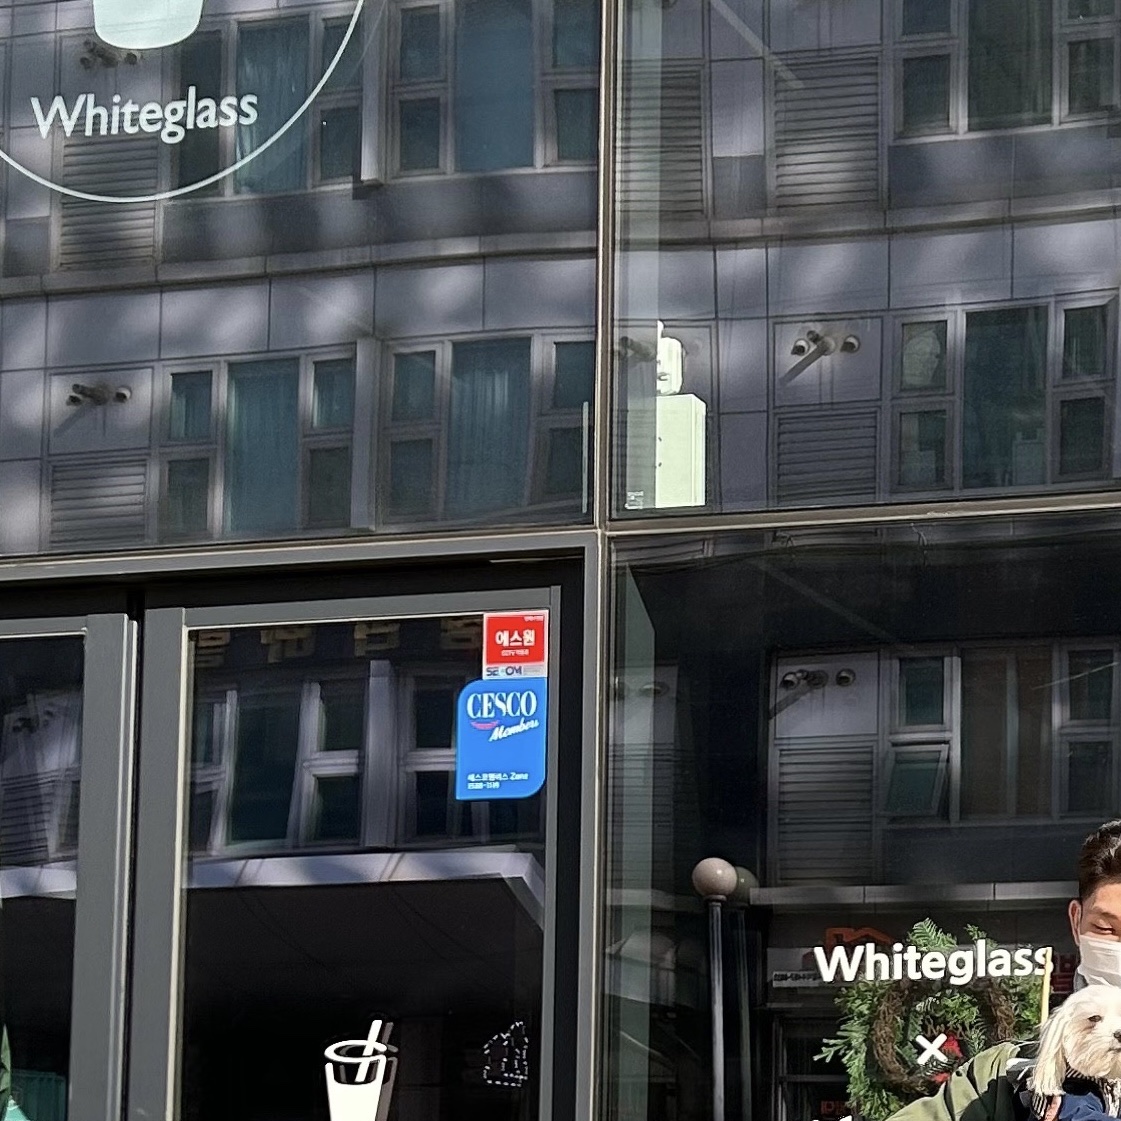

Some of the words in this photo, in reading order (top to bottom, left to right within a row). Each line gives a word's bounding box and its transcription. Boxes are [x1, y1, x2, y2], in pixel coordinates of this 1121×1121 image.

[30, 85, 258, 145] Whiteglass
[496, 629, 535, 647] 에스원
[466, 690, 538, 719] CESCO
[813, 940, 1053, 985] Whiteglass
